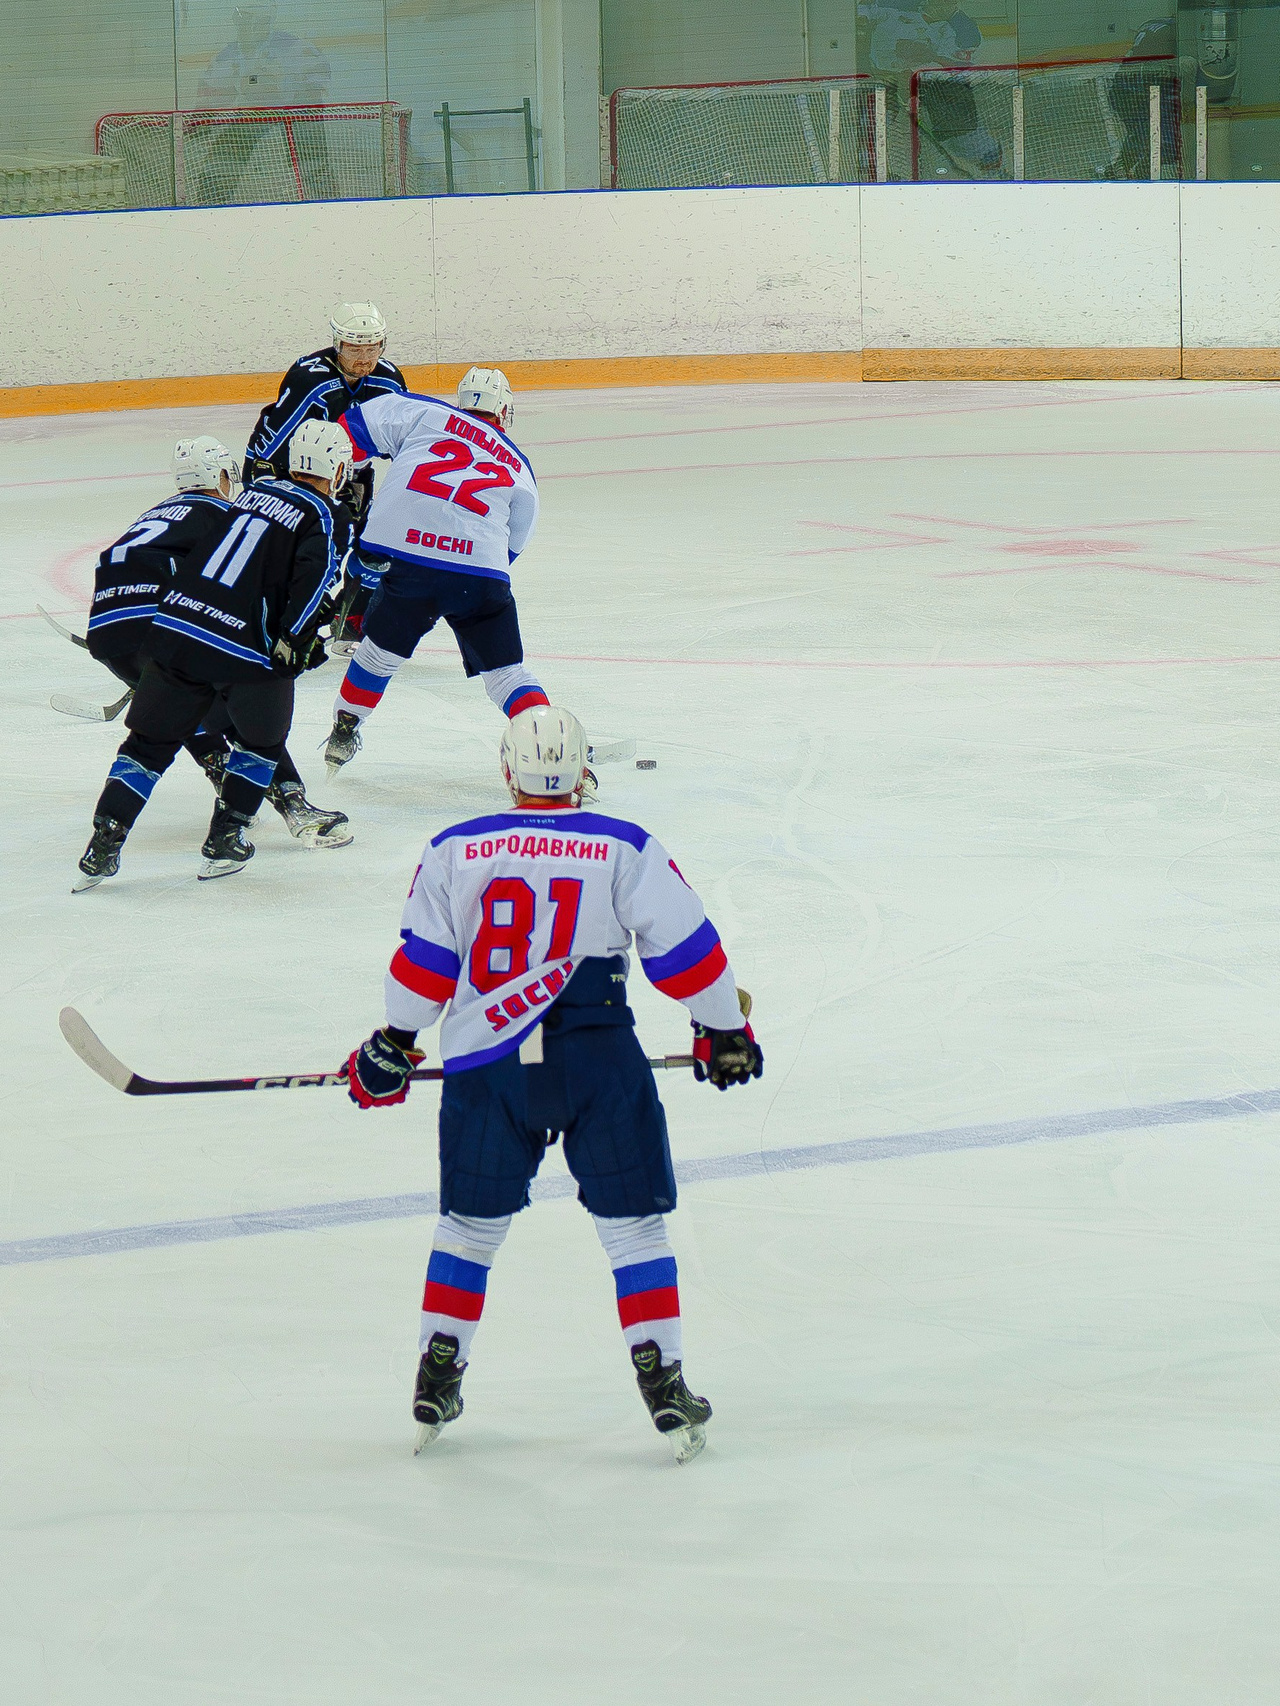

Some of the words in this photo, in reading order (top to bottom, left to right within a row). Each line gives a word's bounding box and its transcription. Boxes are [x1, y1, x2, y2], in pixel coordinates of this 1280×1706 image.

[473, 393, 481, 406] 7
[444, 414, 521, 473] КОПЫЛОВ
[299, 455, 312, 470] 11
[406, 438, 515, 517] 22
[201, 513, 269, 588] 11
[405, 528, 473, 555] SOCHI
[205, 605, 247, 630] TIMER
[545, 776, 559, 790] 12
[465, 835, 608, 861] БОРОДАВКИН
[469, 877, 584, 996] 81
